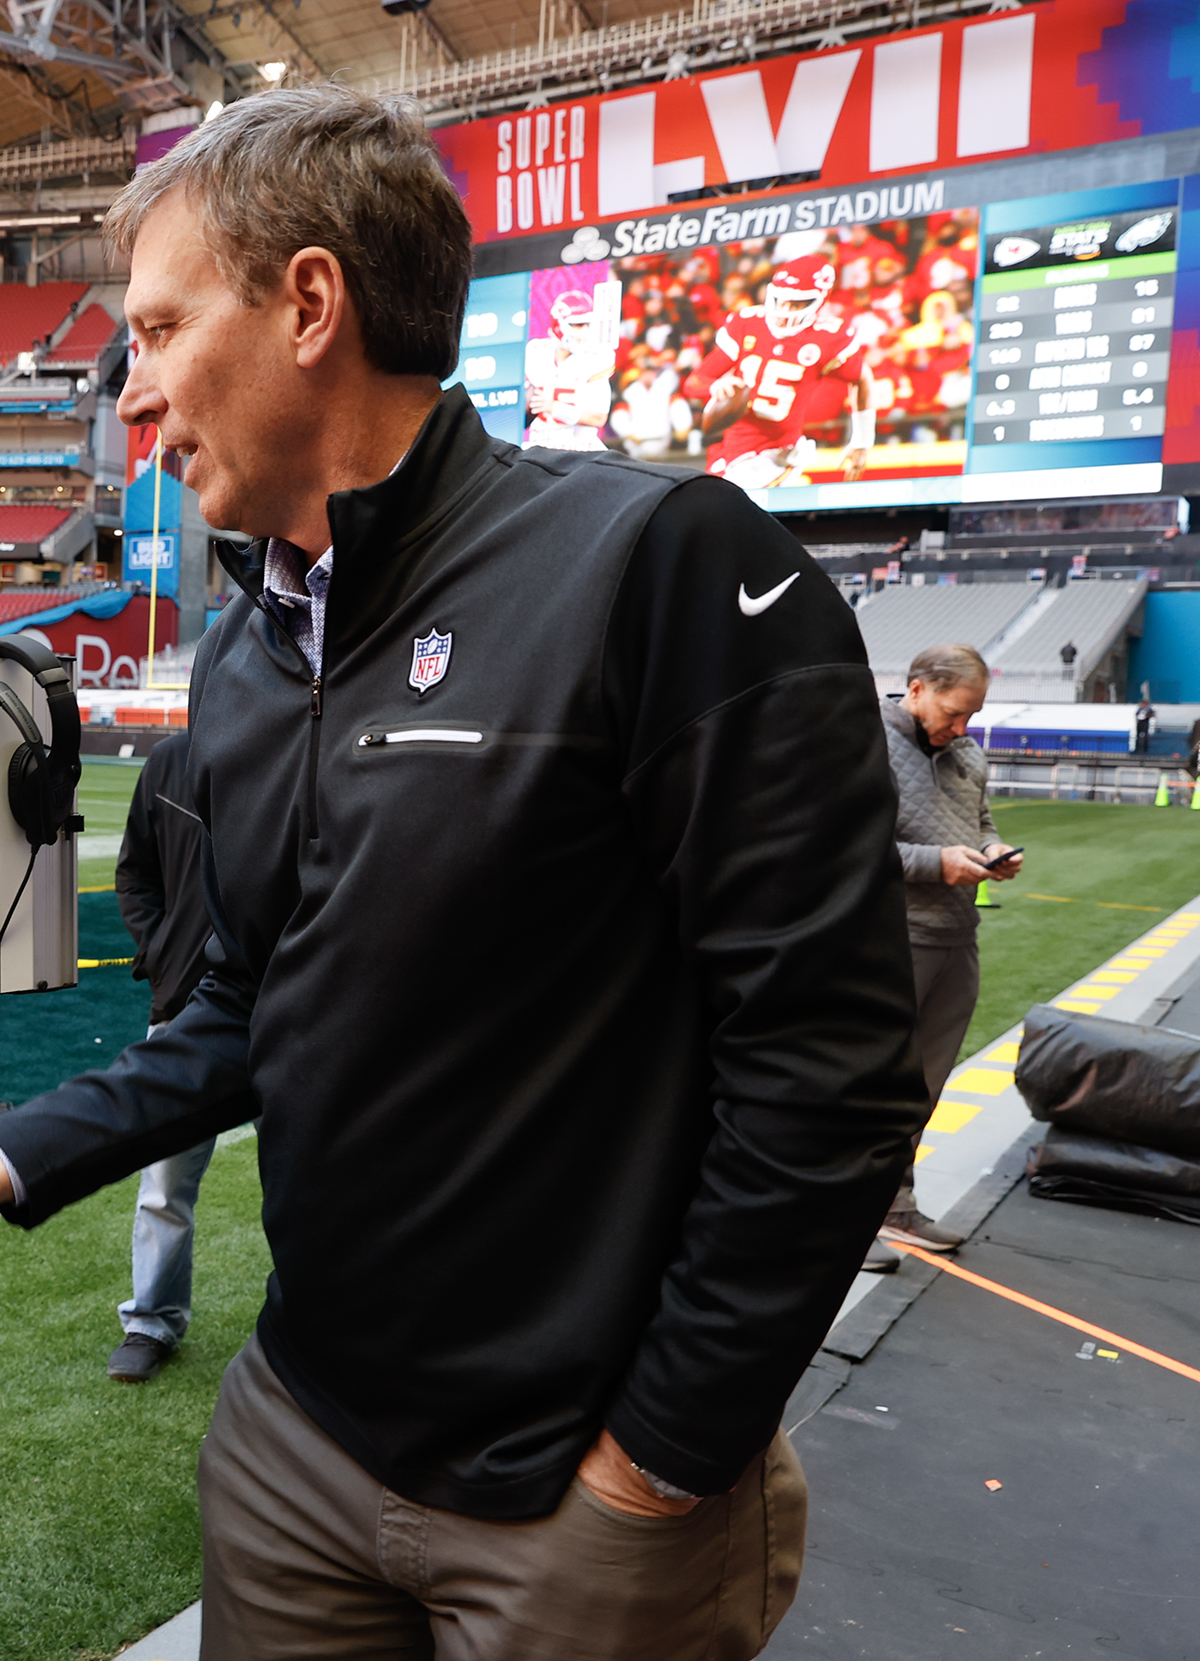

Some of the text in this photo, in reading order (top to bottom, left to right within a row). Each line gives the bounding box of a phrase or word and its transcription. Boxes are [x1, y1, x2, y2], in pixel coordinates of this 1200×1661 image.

[598, 13, 1036, 216] LVII
[497, 105, 585, 174] SUPER
[496, 161, 585, 233] BOWL
[795, 180, 945, 231] STADIUM
[1049, 227, 1110, 248] STATS
[739, 354, 806, 422] 15
[993, 425, 1005, 441] 1
[1130, 415, 1142, 431] 1
[132, 552, 169, 566] LIGHT
[137, 541, 166, 554] BUD
[416, 656, 441, 681] NFL
